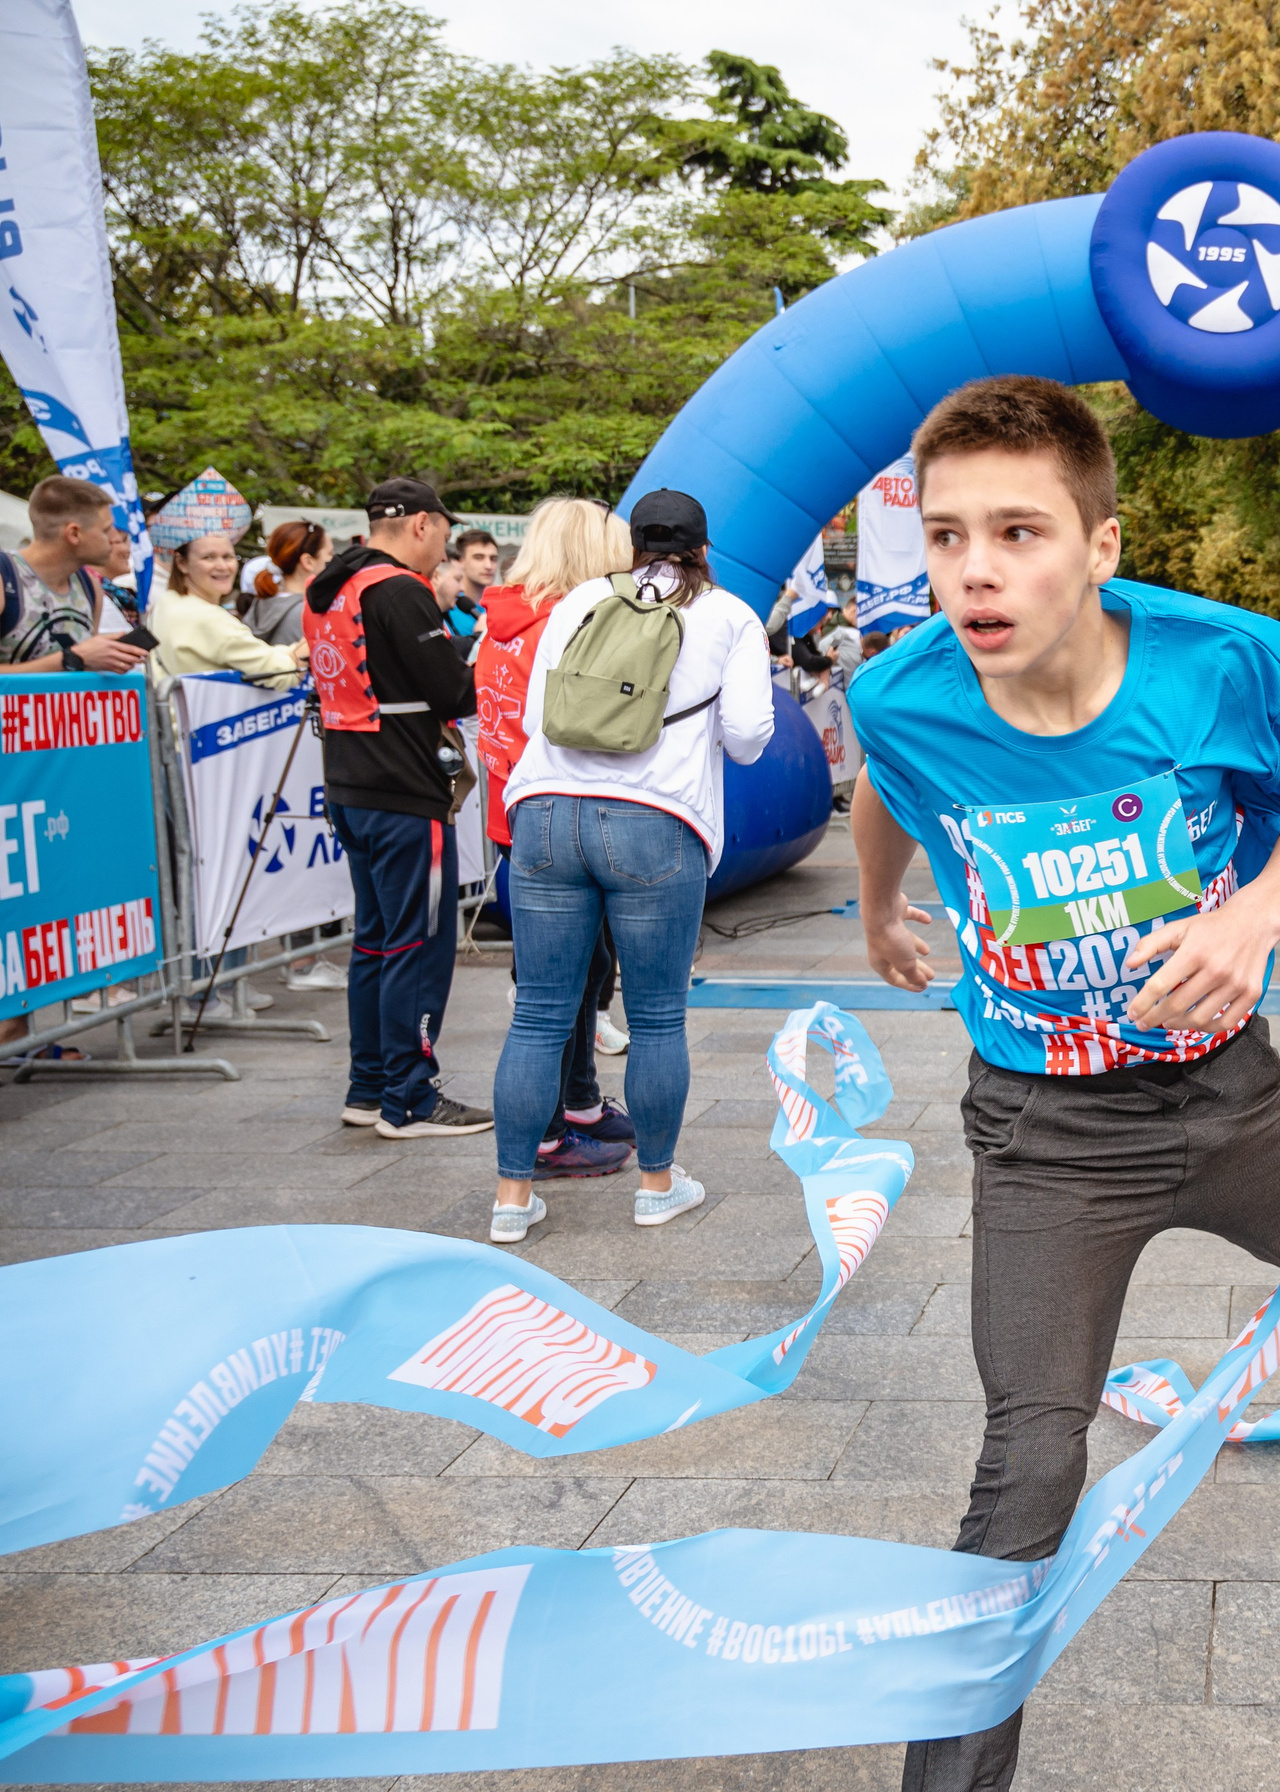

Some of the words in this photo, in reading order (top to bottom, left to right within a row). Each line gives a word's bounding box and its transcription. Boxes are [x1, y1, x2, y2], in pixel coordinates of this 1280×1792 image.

[1198, 246, 1246, 262] 1995
[871, 476, 914, 493] АВТО
[883, 492, 920, 508] РАДИ
[858, 585, 913, 614] АБЕГ.РФ
[1, 690, 142, 754] #ЕДИНСТВО
[995, 811, 1027, 824] ПСБ
[1186, 799, 1217, 843] БЕГ
[1022, 833, 1149, 899] 10251
[75, 898, 156, 974] #ЦЕЛЬ
